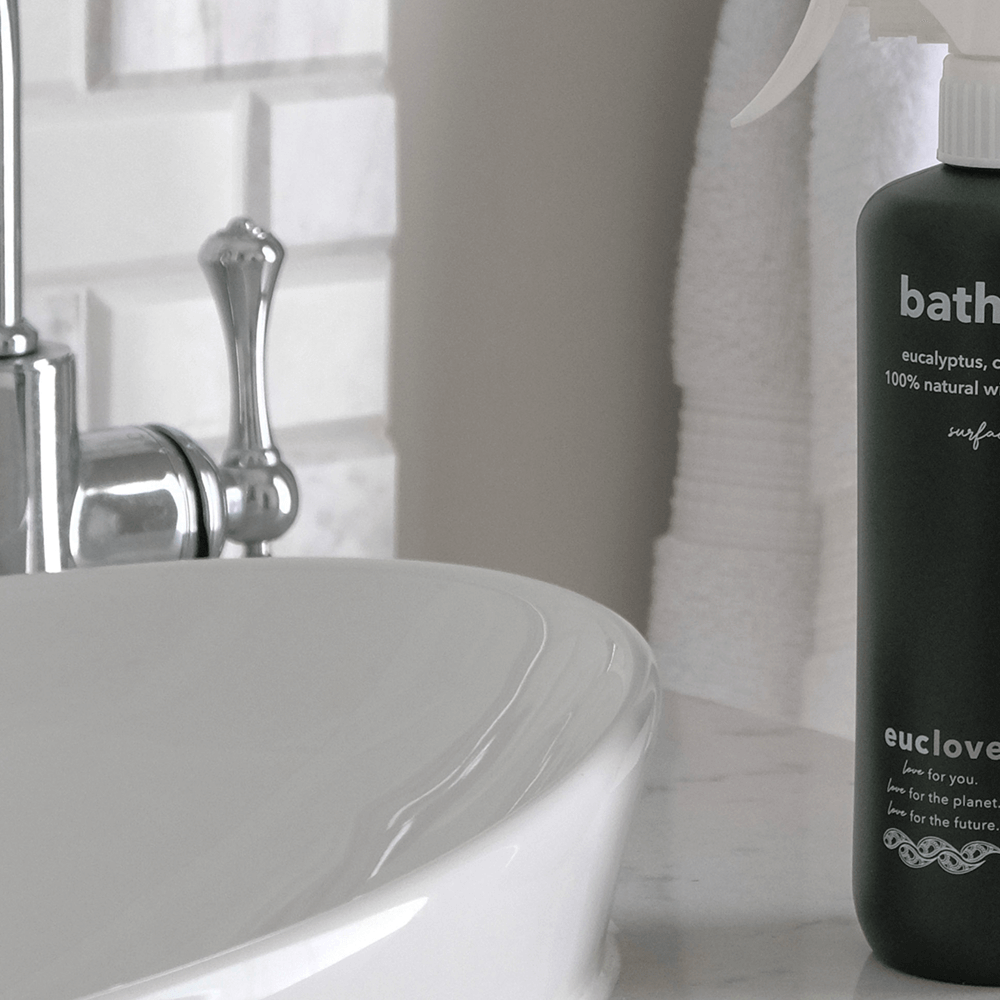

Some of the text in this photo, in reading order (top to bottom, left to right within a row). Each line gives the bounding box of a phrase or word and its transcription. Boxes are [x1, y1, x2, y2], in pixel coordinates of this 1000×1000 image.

[901, 349, 988, 371] eucalyptus,
[885, 369, 921, 390] 100%
[924, 378, 979, 396] natural
[902, 759, 978, 787] love for you.
[887, 778, 1000, 809] love for the planet.
[887, 800, 1000, 831] love for the future.
